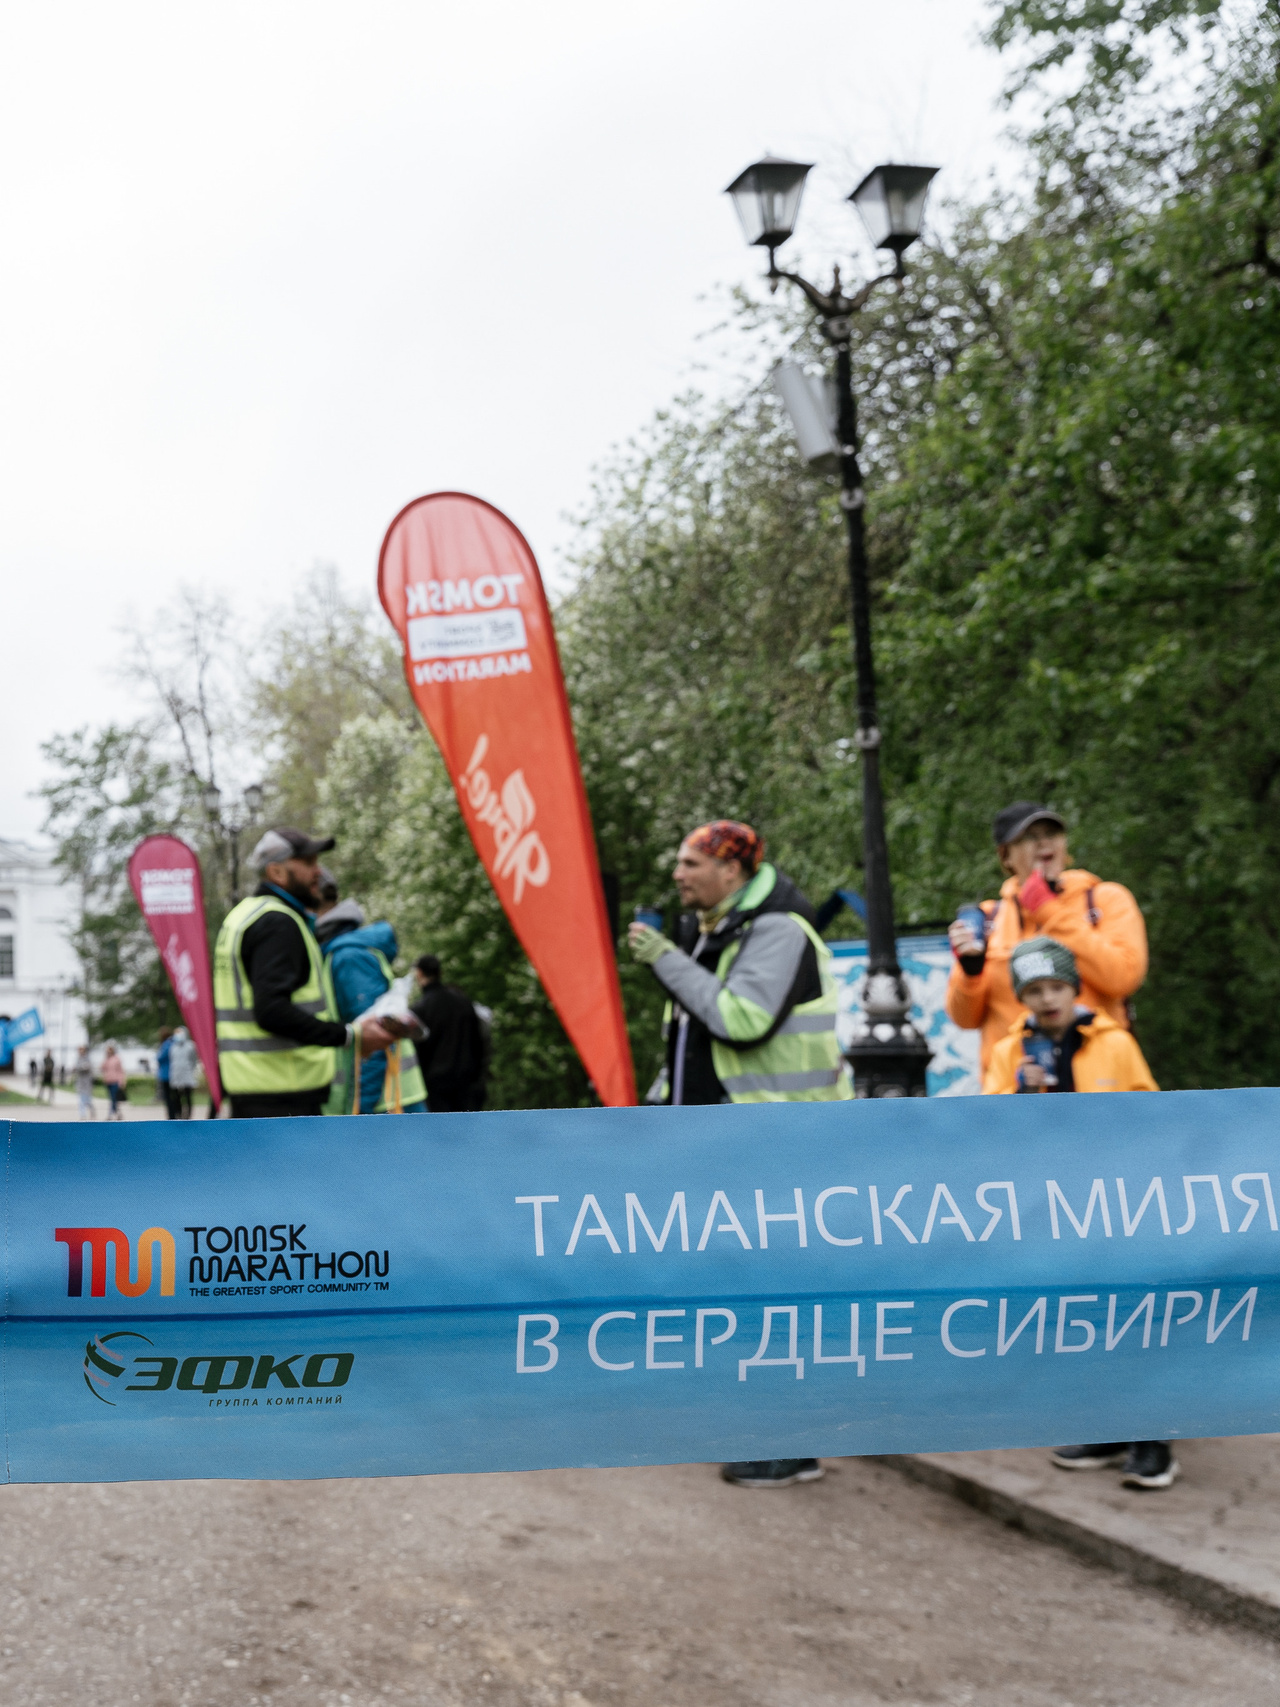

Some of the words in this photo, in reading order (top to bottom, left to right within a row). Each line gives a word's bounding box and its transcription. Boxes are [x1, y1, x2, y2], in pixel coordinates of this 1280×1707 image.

[515, 1181, 1021, 1256] ТАМАНСКАЯ
[1046, 1172, 1279, 1239] МИЛЯ
[184, 1224, 307, 1254] TOMSK
[189, 1250, 390, 1284] MARATHON
[189, 1287, 210, 1297] THE
[213, 1286, 267, 1297] GREATEST
[269, 1284, 304, 1295] SPORT
[307, 1282, 371, 1293] COMMUNITY
[374, 1281, 390, 1291] TM
[515, 1314, 559, 1373] В
[587, 1301, 914, 1381] СЕРДЦЕ
[940, 1287, 1258, 1359] СИБИРИ
[125, 1352, 355, 1394] ЭФКО
[208, 1399, 259, 1408] ГРУППА
[266, 1394, 343, 1406] КОМПАНИЙ
